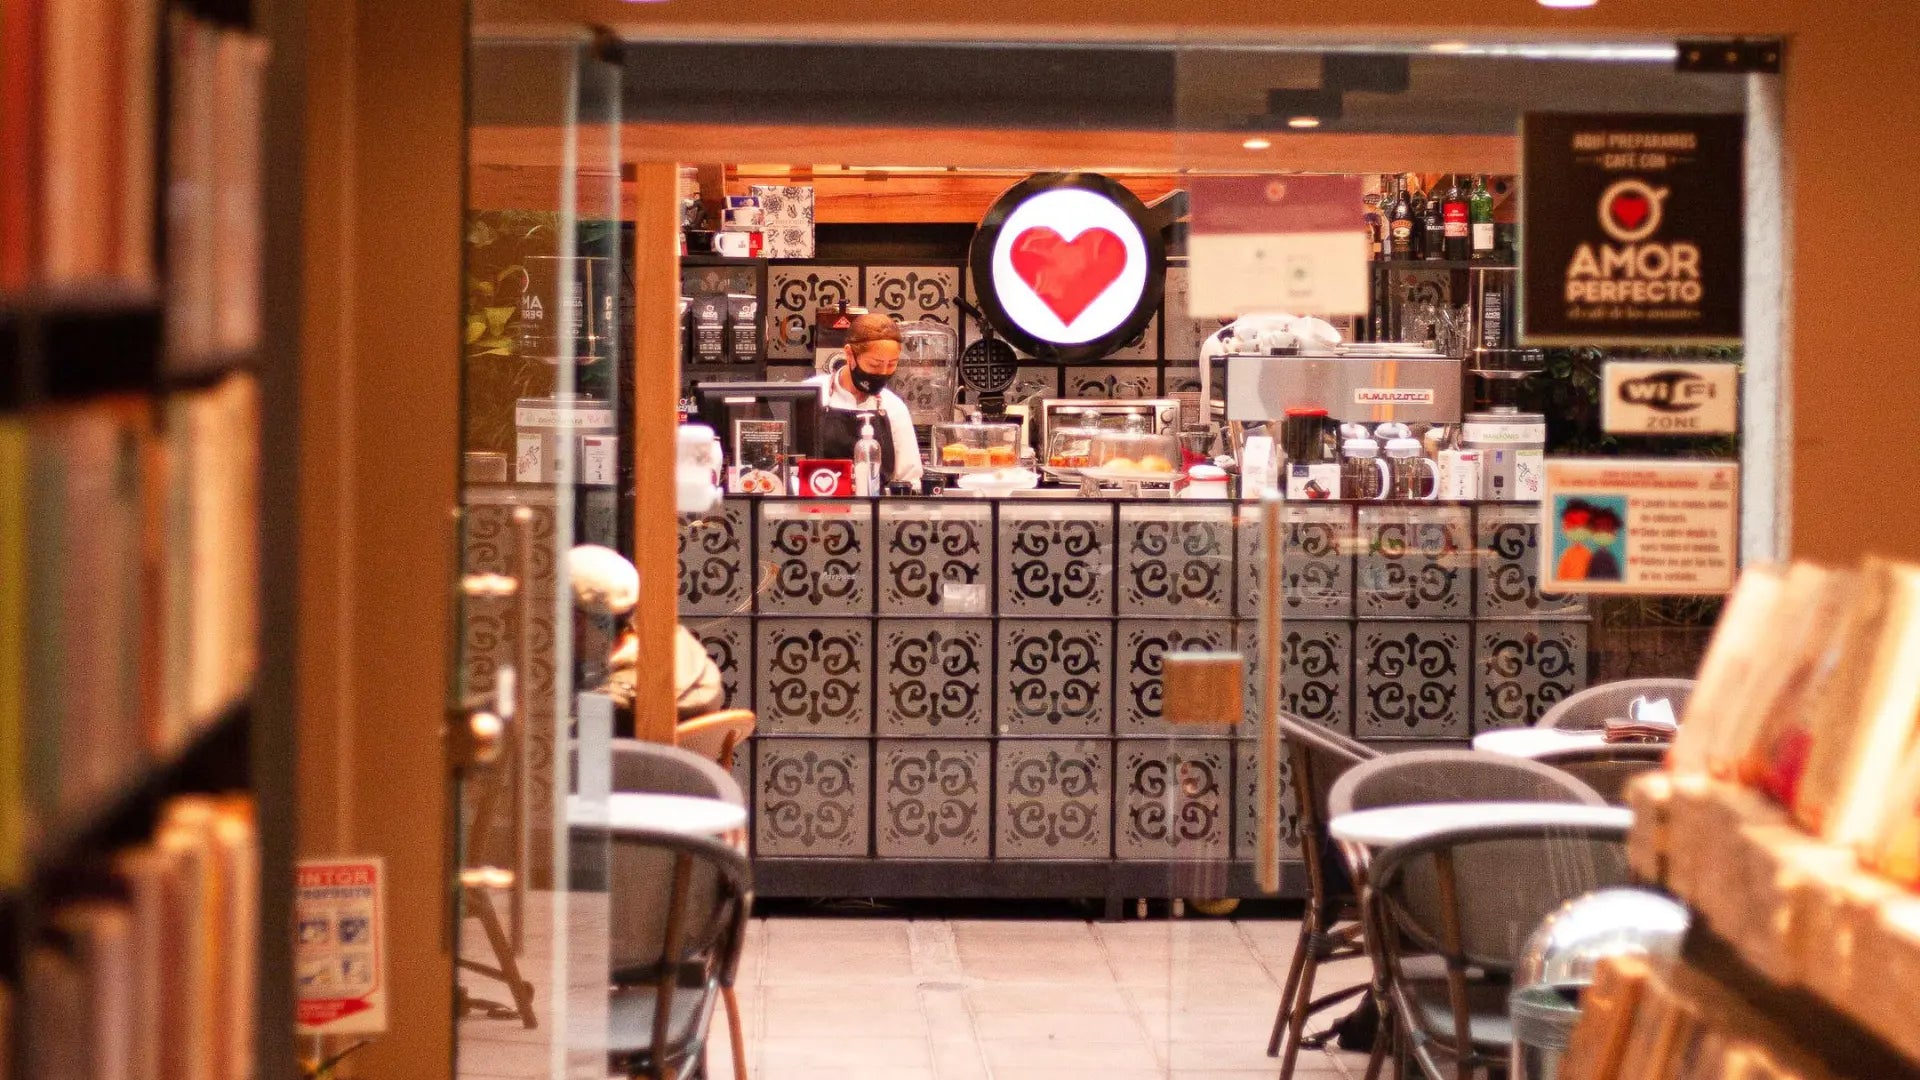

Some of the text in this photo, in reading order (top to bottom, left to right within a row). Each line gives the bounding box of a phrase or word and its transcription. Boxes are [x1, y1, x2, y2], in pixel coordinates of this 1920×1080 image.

[1566, 243, 1700, 278] AMOR
[1565, 280, 1702, 303] PERFECTO
[1647, 416, 1698, 428] ZONE
